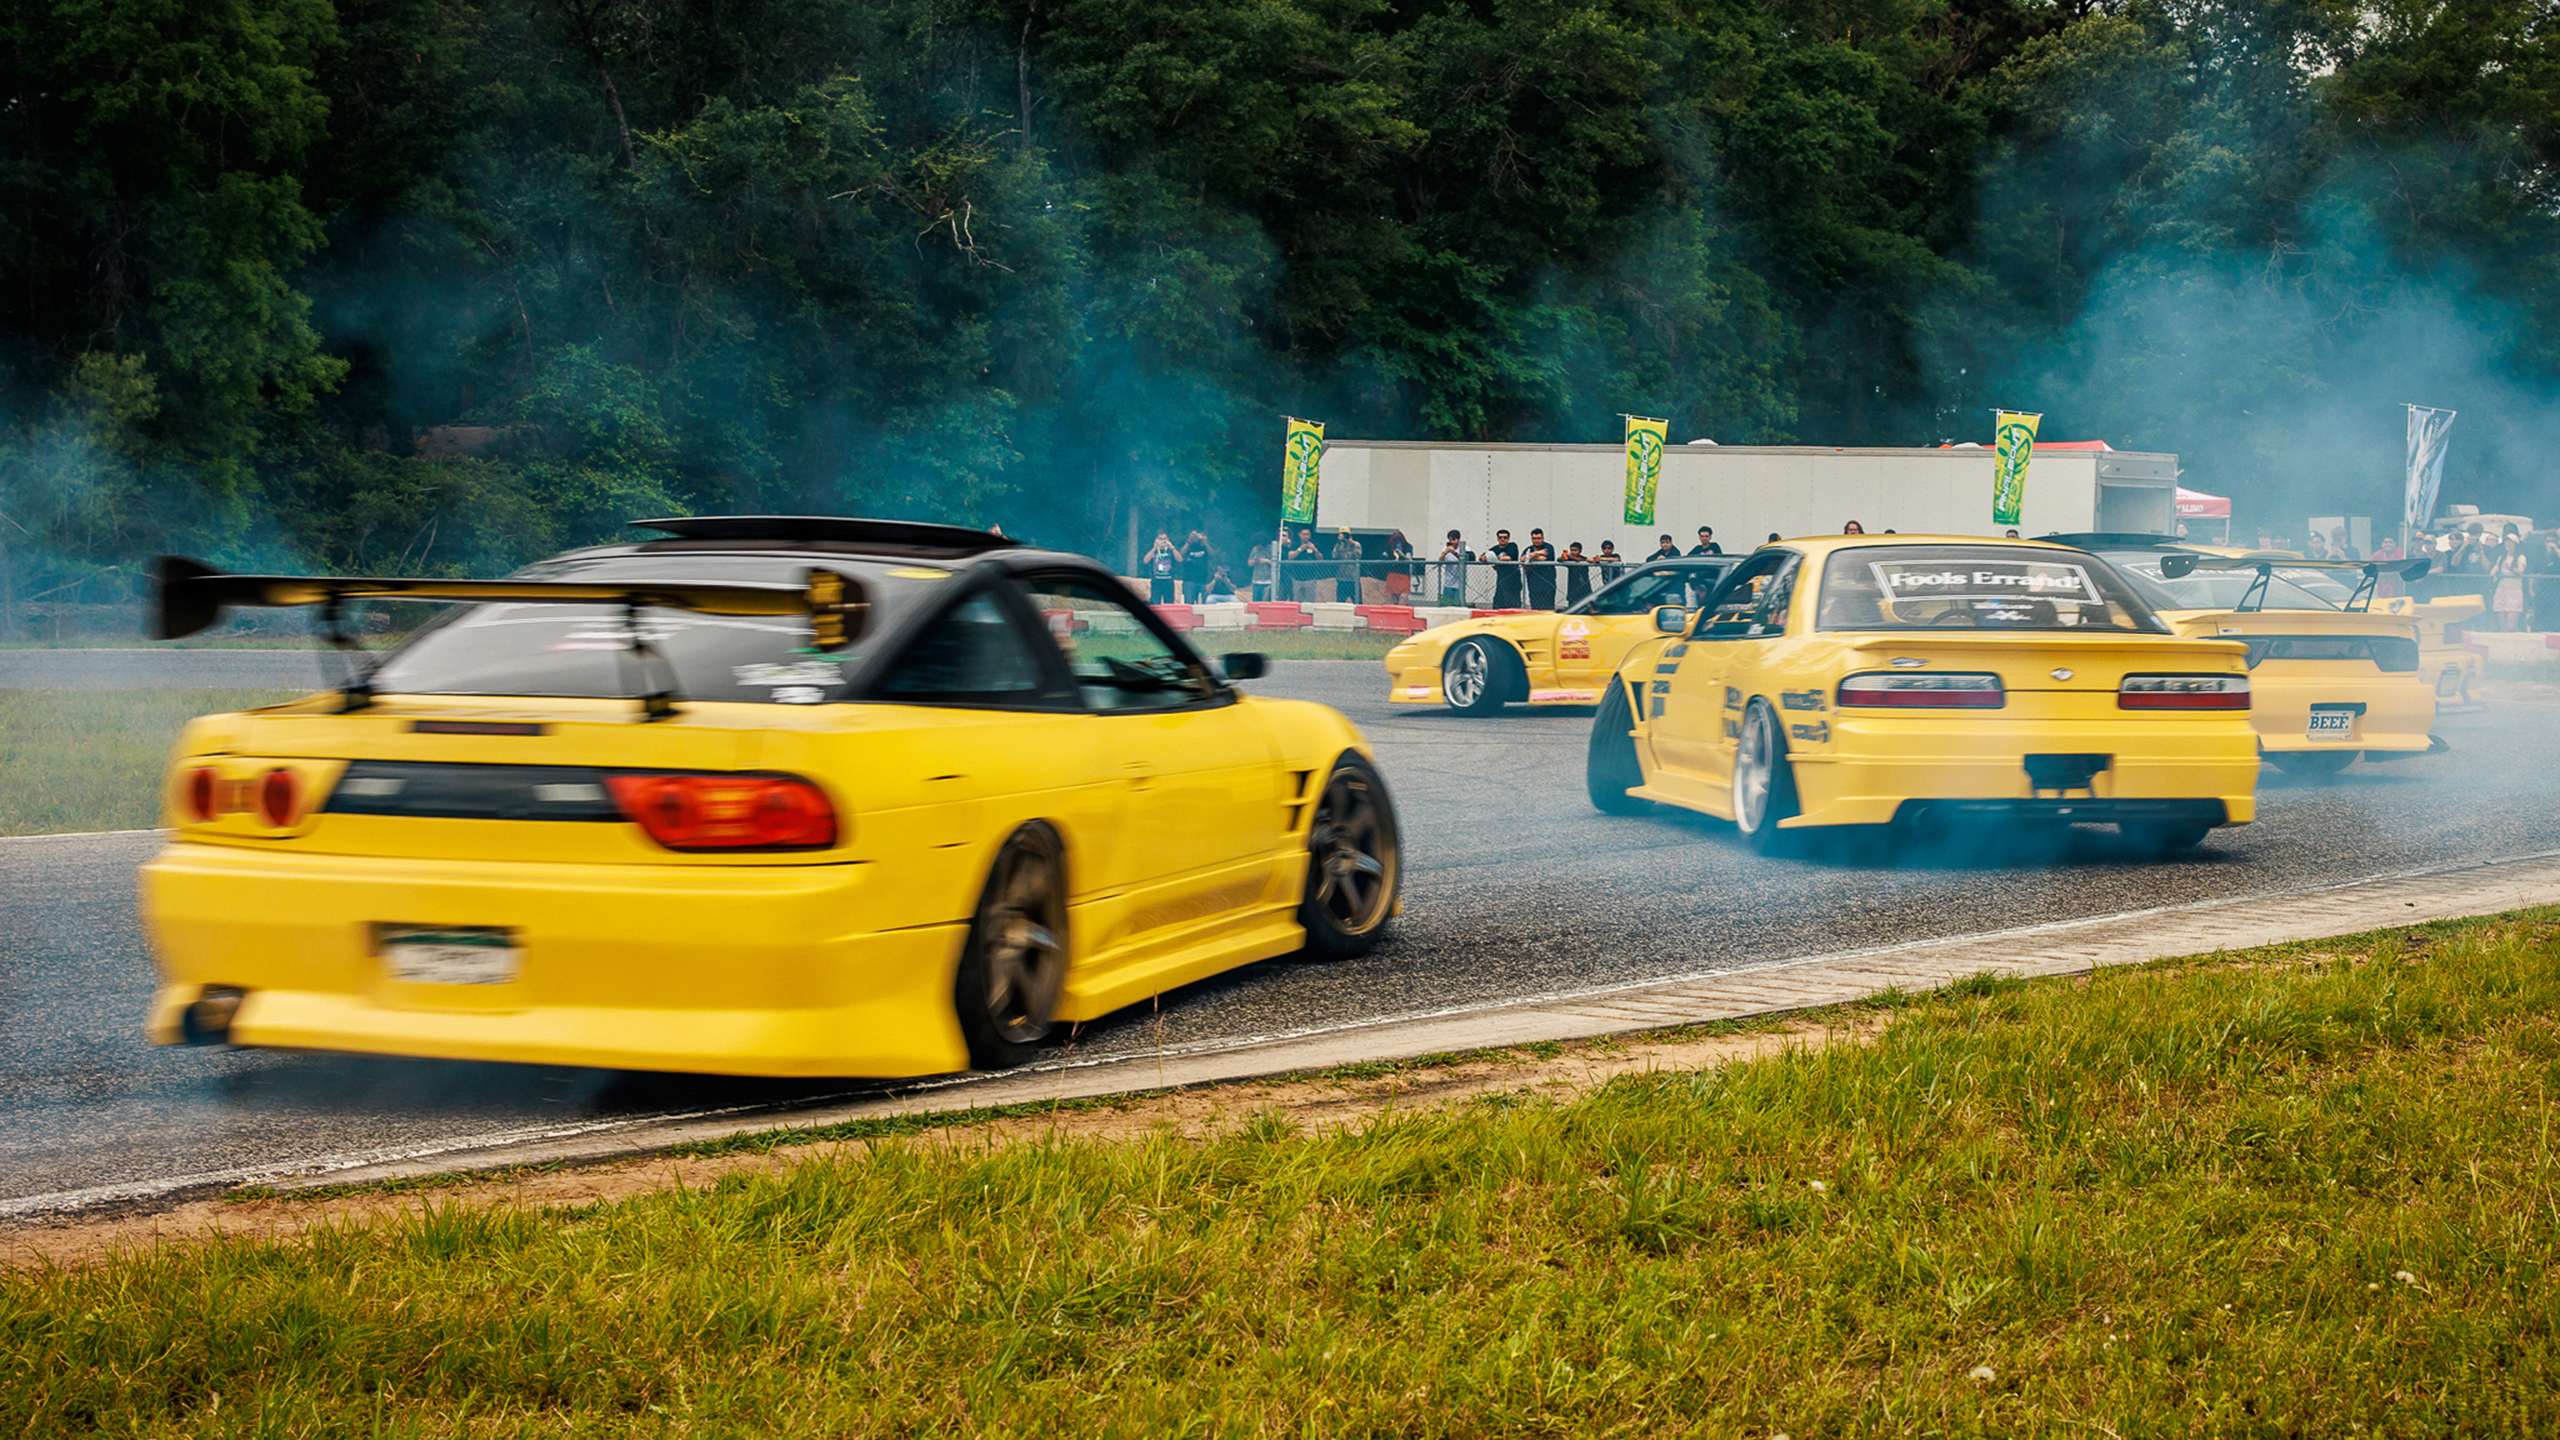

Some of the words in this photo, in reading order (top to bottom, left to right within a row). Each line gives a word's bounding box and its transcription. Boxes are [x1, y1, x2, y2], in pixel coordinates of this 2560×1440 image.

[1293, 473, 1306, 511] FINAL
[1300, 435, 1311, 473] BOUT
[1640, 432, 1651, 474] BOUT
[1998, 470, 2013, 512] FINAL
[2006, 427, 2020, 471] BOUT
[1635, 473, 1647, 514] FINAL
[1889, 571, 1968, 587] Fools
[1971, 571, 2082, 589] Errand!
[2309, 716, 2349, 729] BEEF.
